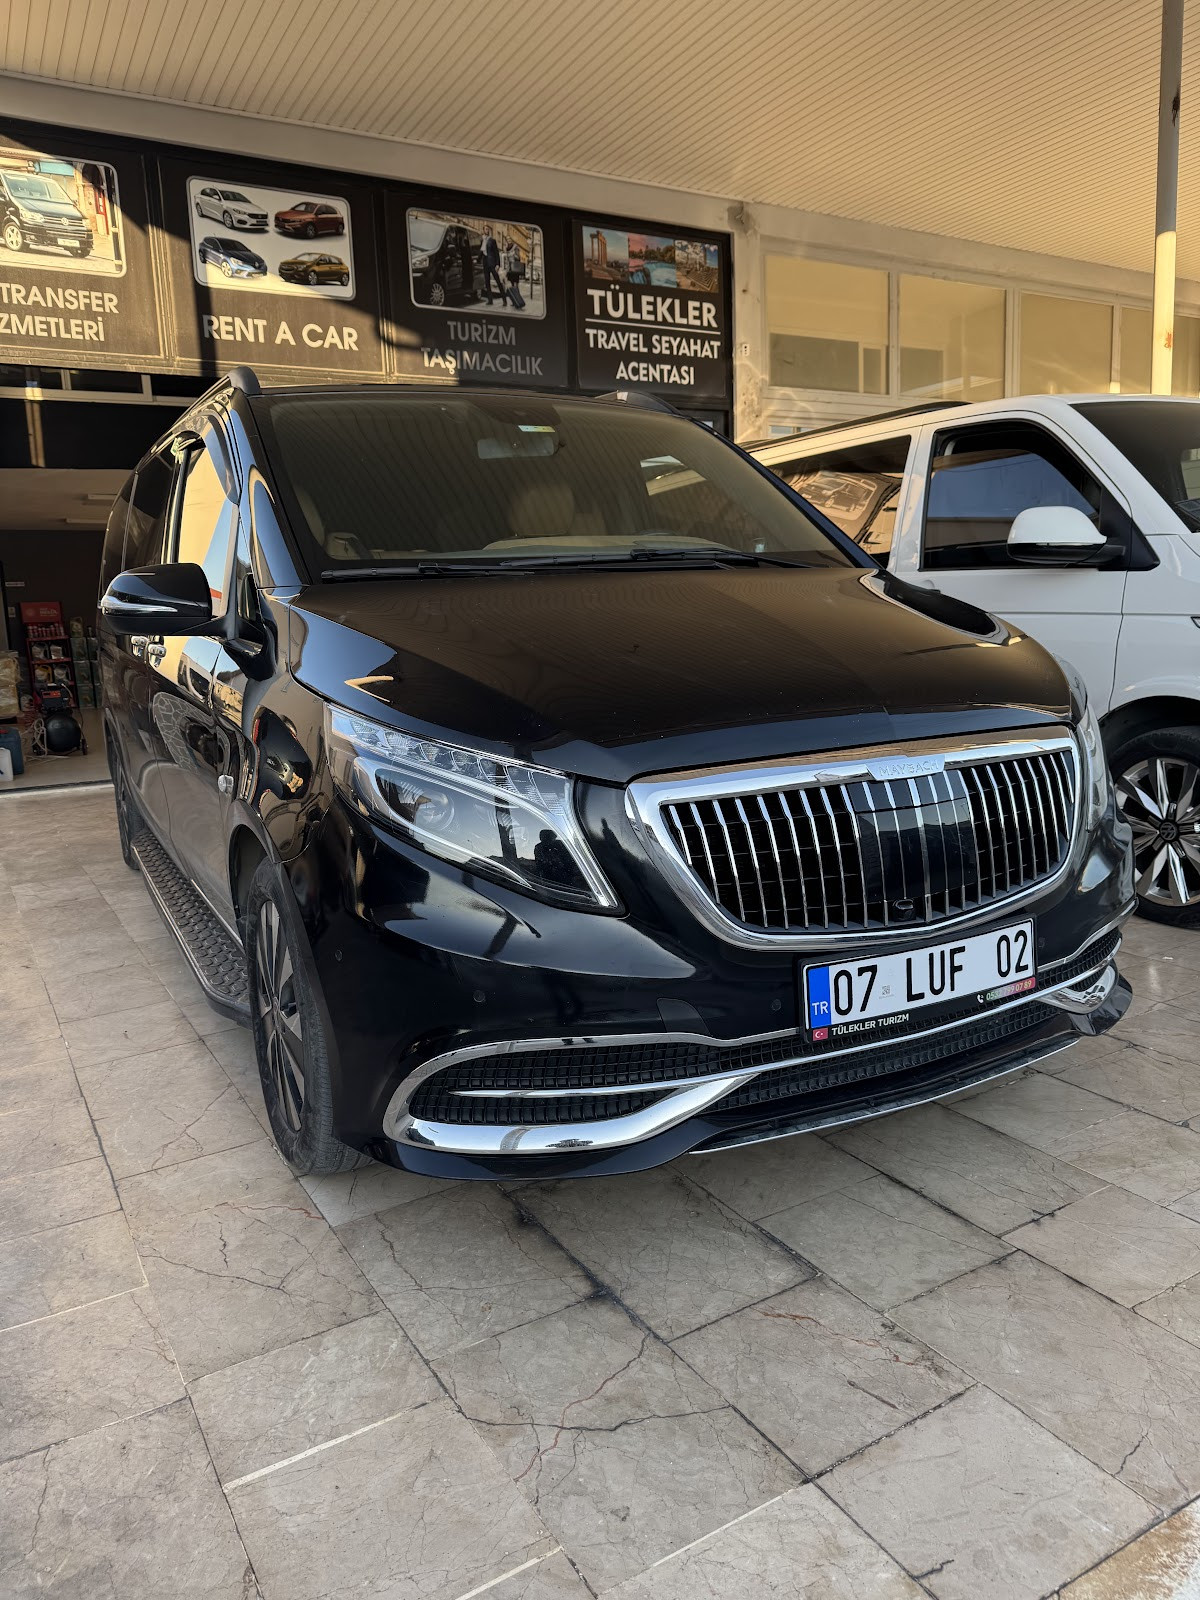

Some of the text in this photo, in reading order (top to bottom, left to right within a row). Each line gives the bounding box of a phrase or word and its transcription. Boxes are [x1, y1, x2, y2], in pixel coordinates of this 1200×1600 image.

[0, 282, 119, 314] TRANSFER
[586, 284, 719, 328] TÜLEKLER
[203, 314, 359, 351] RENT A CAR
[447, 320, 516, 346] TURİZM
[585, 328, 721, 359] TRAVEL SEYAHAT
[421, 347, 544, 376] TAŞIMACILIK
[616, 361, 695, 386] ACENTASI
[878, 759, 939, 777] MAYBACH
[833, 930, 1029, 1016] 07 LUF 02
[812, 1001, 828, 1016] TR
[831, 1020, 876, 1036] TÜLEKLER
